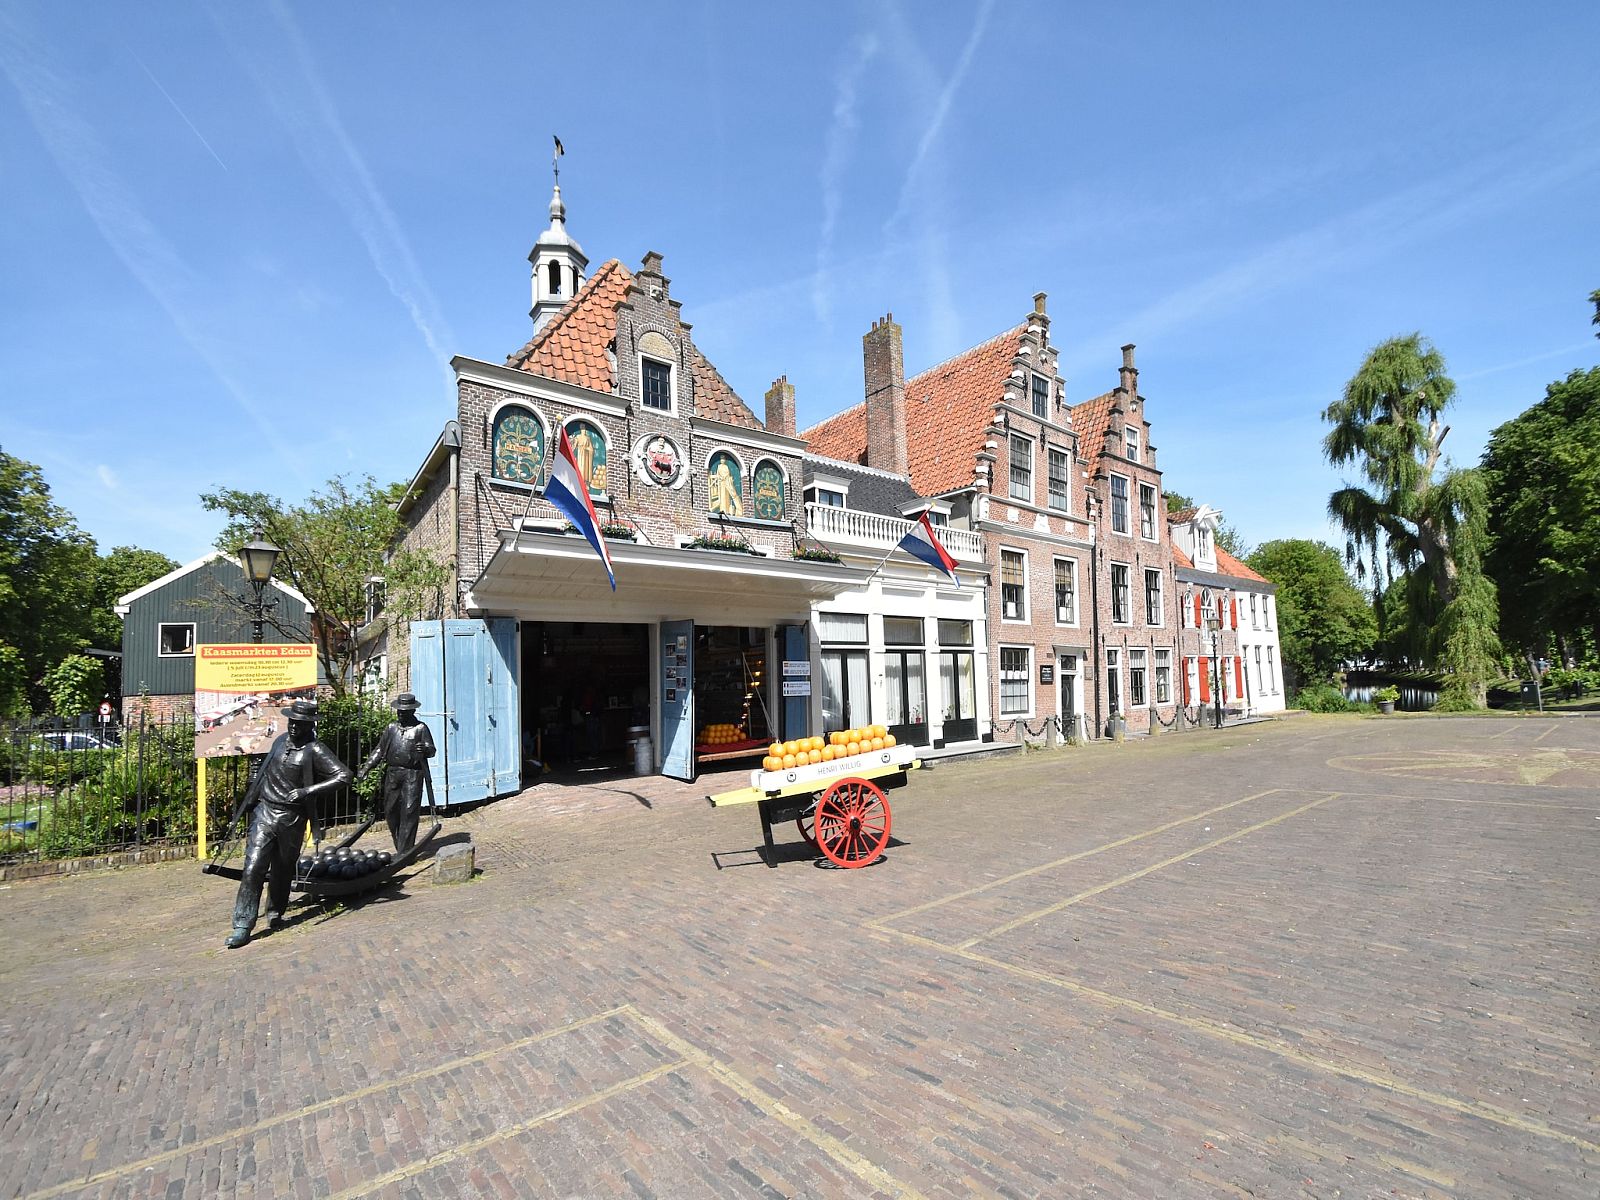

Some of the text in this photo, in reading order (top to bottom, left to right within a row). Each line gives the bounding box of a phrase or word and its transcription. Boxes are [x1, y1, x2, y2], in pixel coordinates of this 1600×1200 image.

[204, 647, 311, 656] Kaasmarkten Edam
[817, 760, 861, 775] HENRI WILLIG
